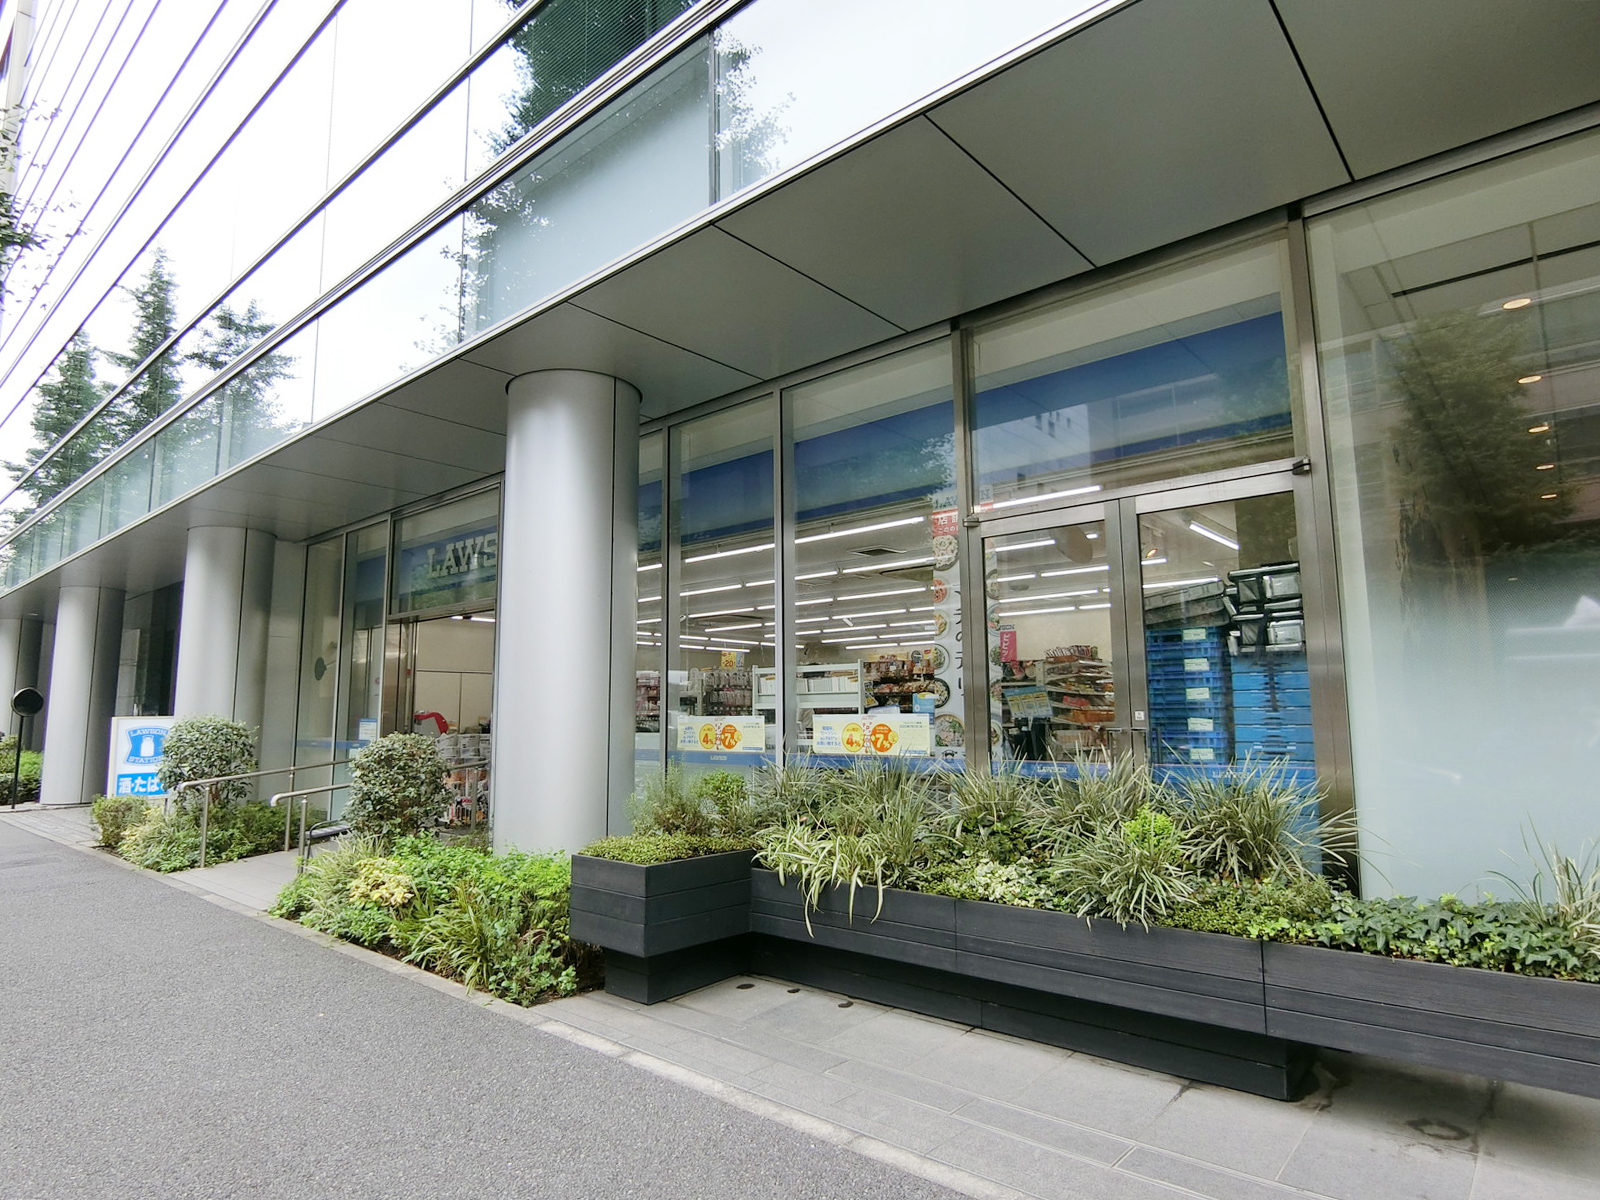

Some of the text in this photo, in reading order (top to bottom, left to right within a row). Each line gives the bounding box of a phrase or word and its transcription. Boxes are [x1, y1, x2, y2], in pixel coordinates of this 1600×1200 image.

[130, 729, 167, 737] LAWSON
[875, 733, 891, 749] 7%
[119, 776, 163, 794] 酒・たば
